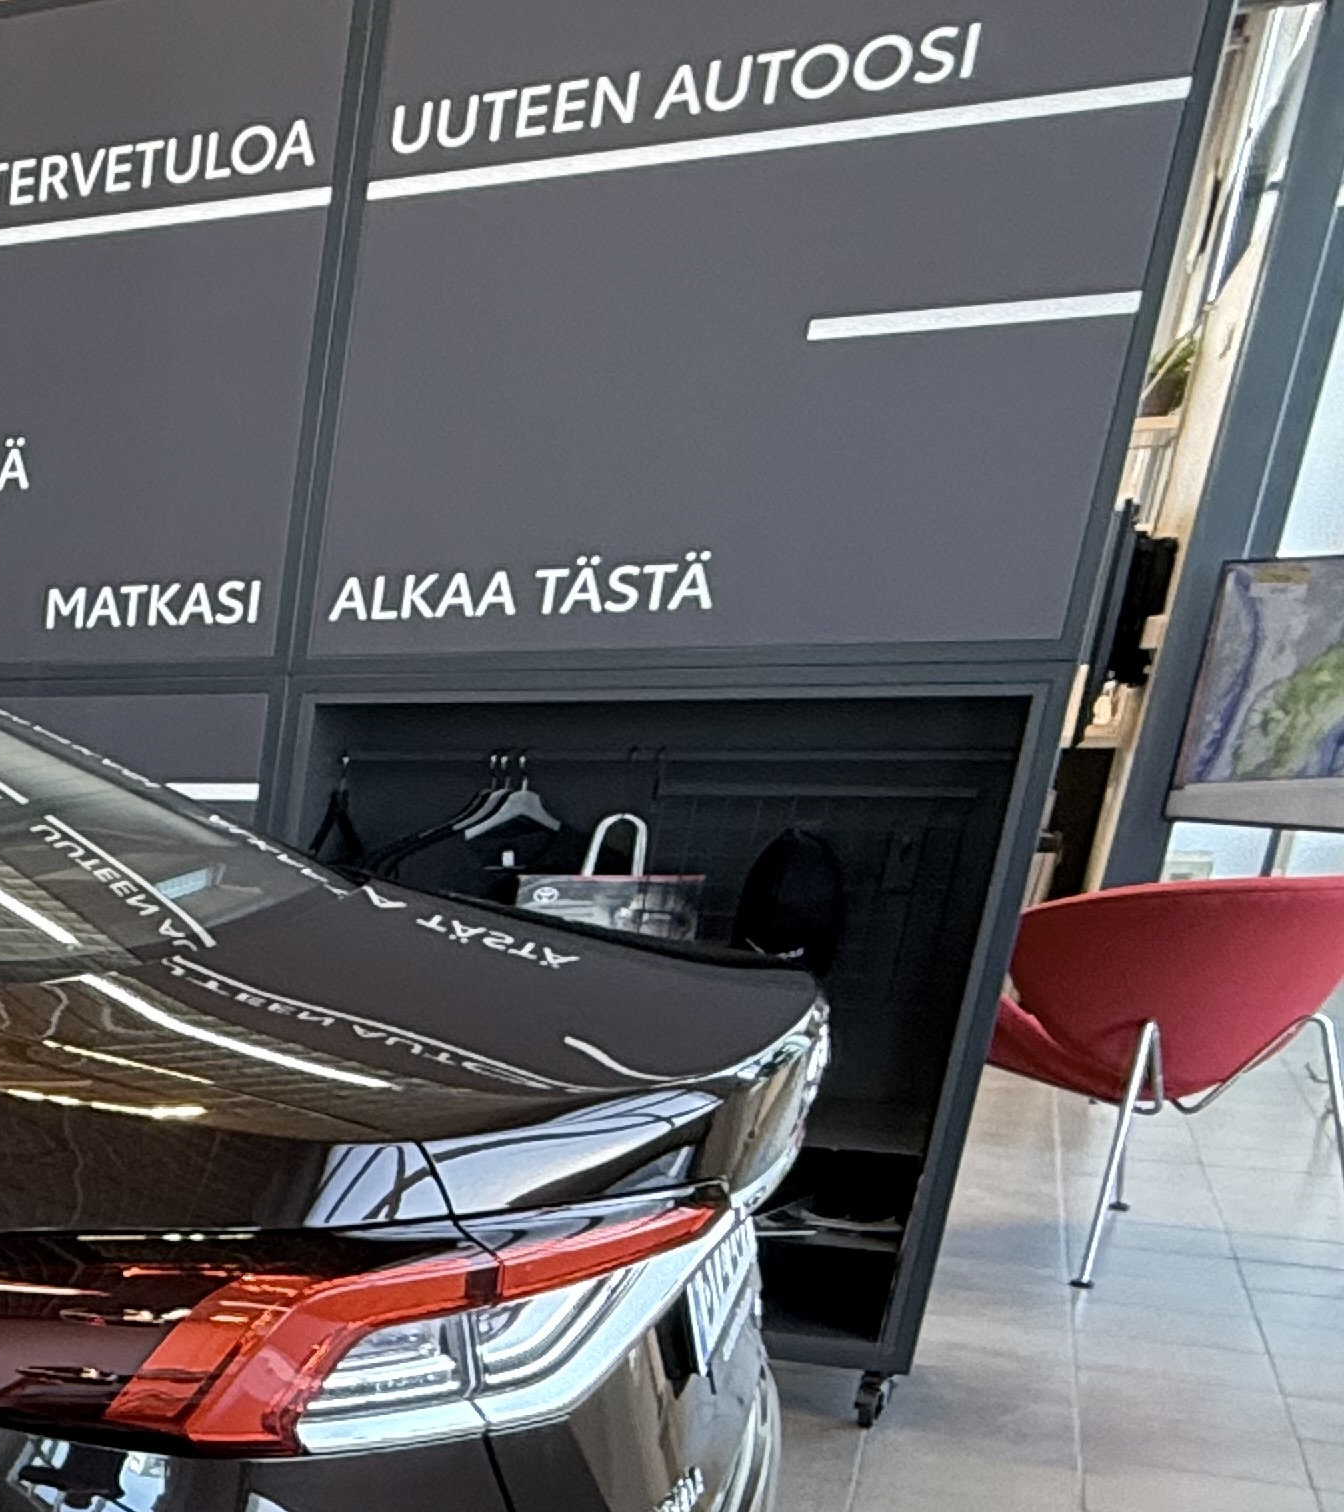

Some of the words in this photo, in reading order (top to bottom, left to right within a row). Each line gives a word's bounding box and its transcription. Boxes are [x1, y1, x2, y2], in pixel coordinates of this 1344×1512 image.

[391, 70, 641, 155] UUTEEN
[654, 22, 982, 120] AUTOOSI
[45, 580, 262, 630] MATKASI
[328, 570, 516, 622] ALKAA
[534, 550, 713, 616] TÄSTÄ
